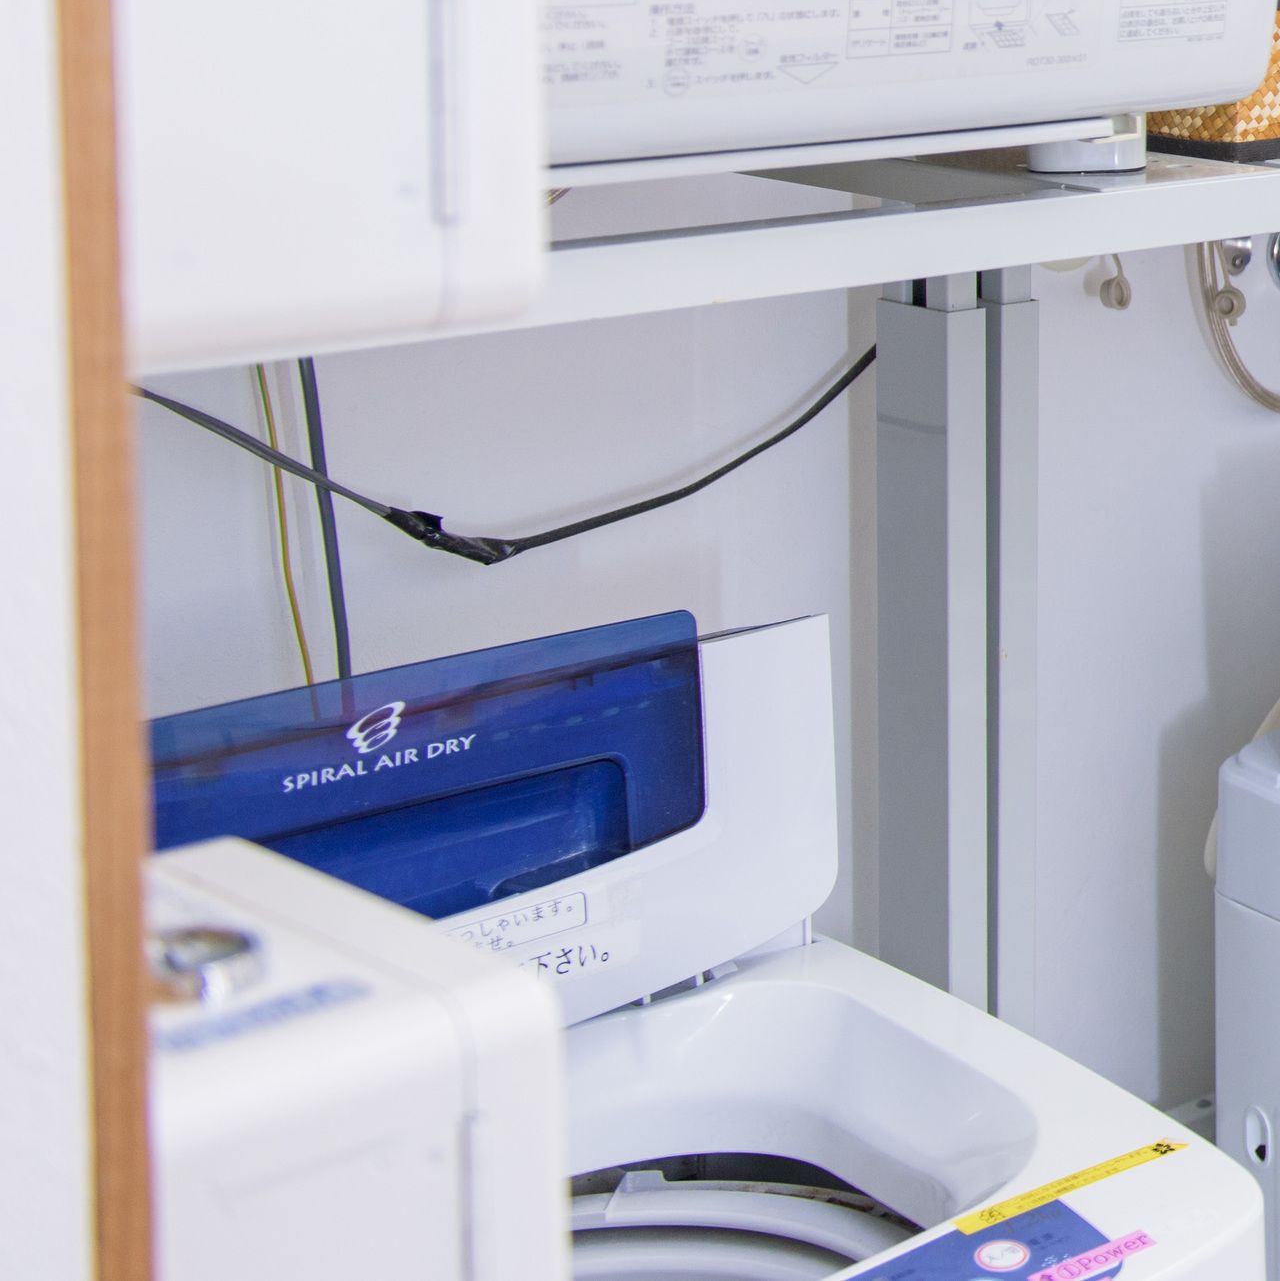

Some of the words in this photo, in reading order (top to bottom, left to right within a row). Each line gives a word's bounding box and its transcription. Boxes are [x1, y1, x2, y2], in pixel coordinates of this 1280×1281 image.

[282, 760, 368, 793] SPIRAL
[374, 748, 419, 772] AIR
[427, 734, 476, 759] DRY
[447, 900, 574, 942] っしゃいます。
[521, 945, 611, 979] 下さい。
[1057, 1232, 1148, 1280] ①Power
